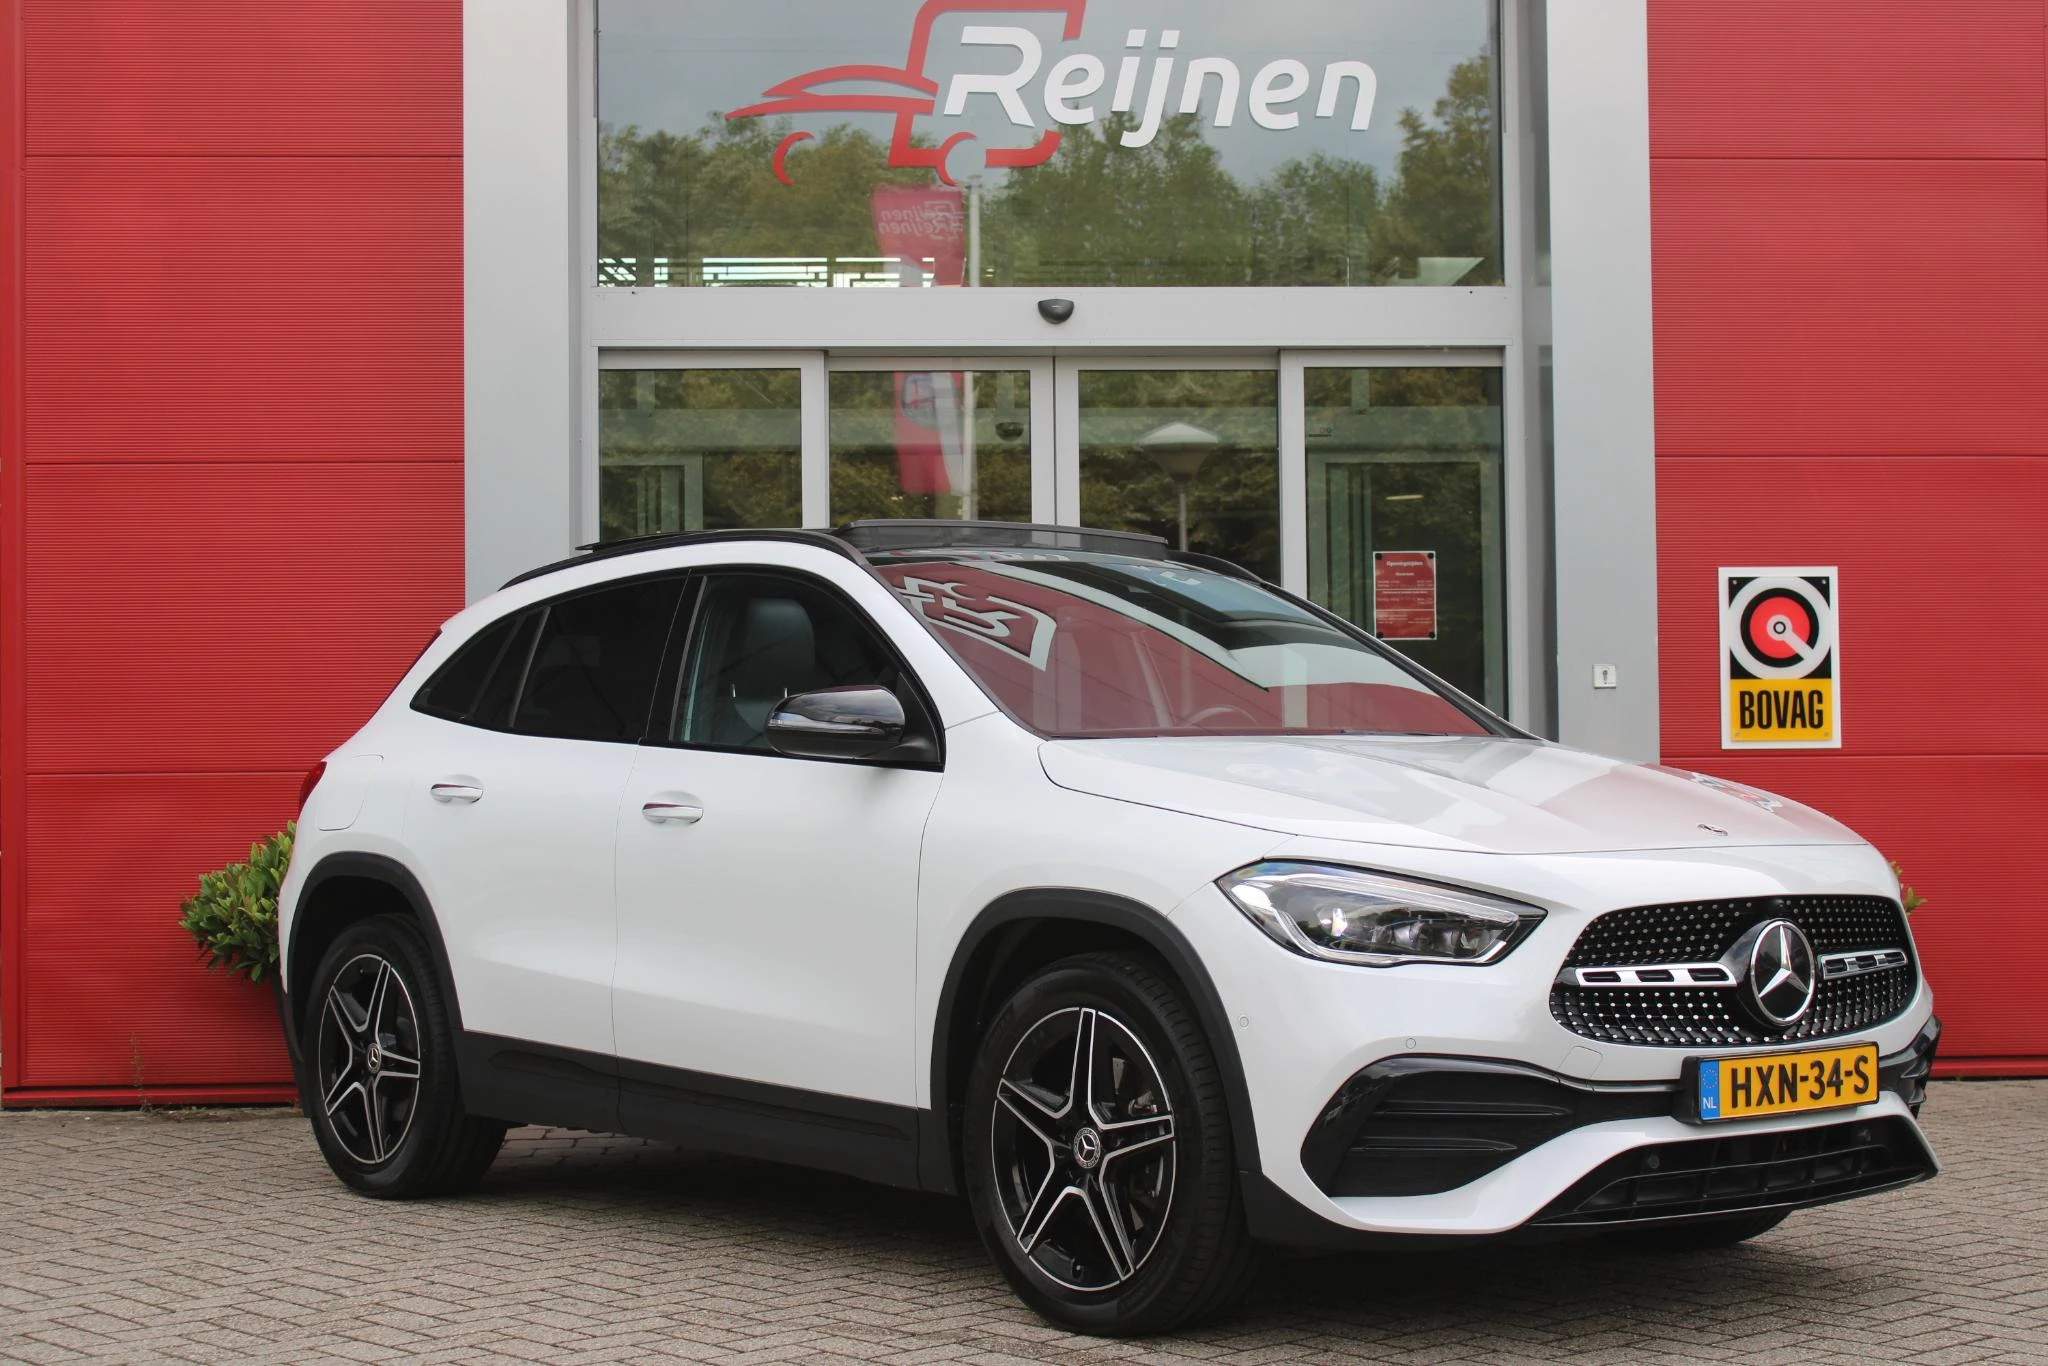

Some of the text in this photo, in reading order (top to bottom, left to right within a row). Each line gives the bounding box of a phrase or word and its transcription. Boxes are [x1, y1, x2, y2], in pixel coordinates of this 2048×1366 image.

[943, 25, 1377, 148] Reijnen
[1739, 689, 1824, 730] BOVAG
[1702, 1055, 1869, 1109] NL HXN-34-S
